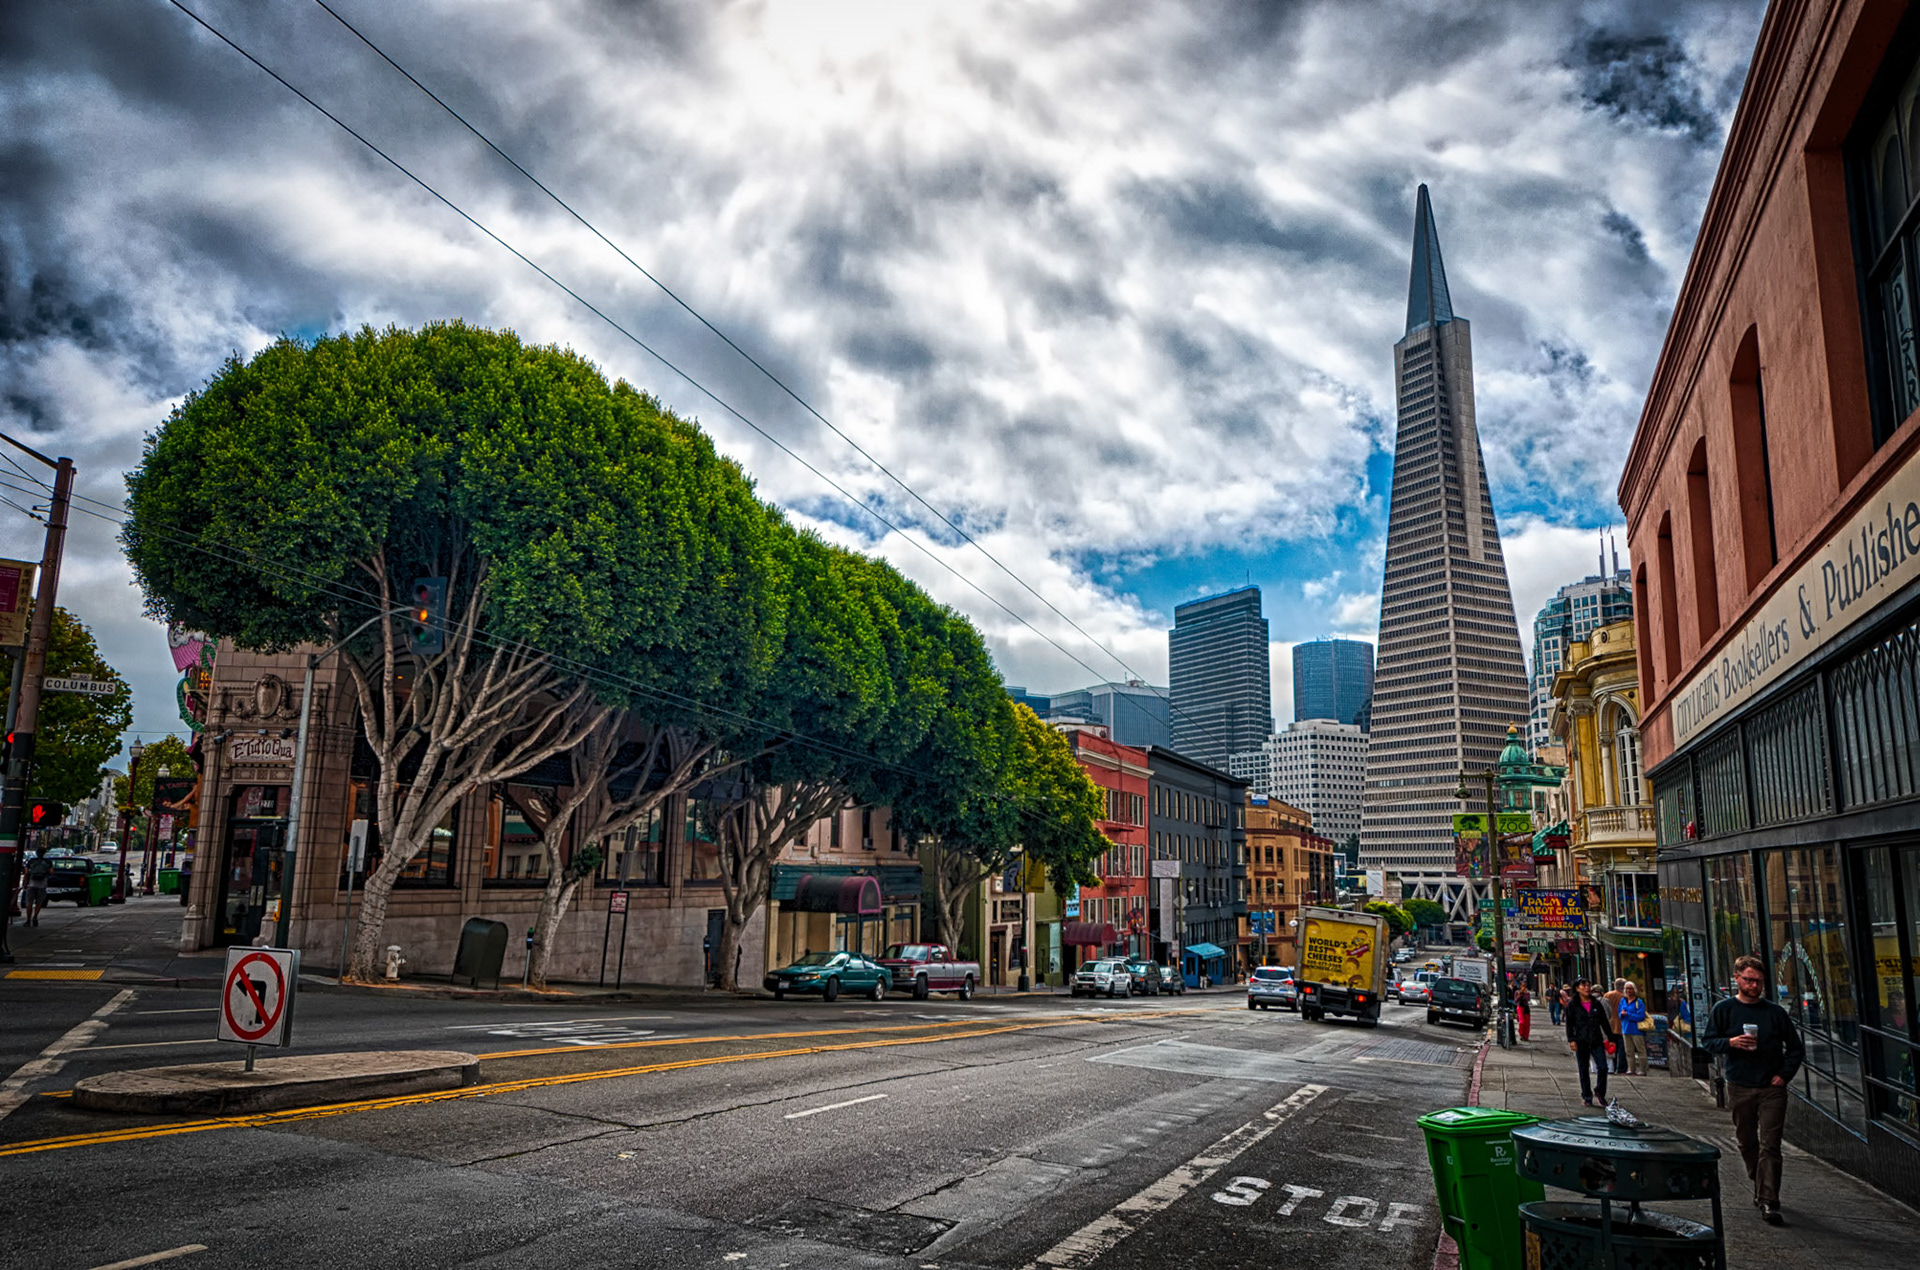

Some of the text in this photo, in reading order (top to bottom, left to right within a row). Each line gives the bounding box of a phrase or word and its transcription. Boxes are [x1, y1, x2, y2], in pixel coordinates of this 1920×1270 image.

[1676, 501, 1920, 738] CITY LIGHTS Booksellers & Publishe
[45, 679, 114, 693] COLUMBUS
[1499, 821, 1530, 832] ZOO
[1527, 897, 1576, 907] PALM &
[1523, 906, 1555, 915] TAROT
[1555, 906, 1582, 915] CARD
[1309, 937, 1348, 949] WORLD'S
[1528, 939, 1547, 947] ATM
[1308, 945, 1328, 953] BEST
[1307, 952, 1343, 963] CHEESES
[1549, 1134, 1650, 1150] RECYCLE
